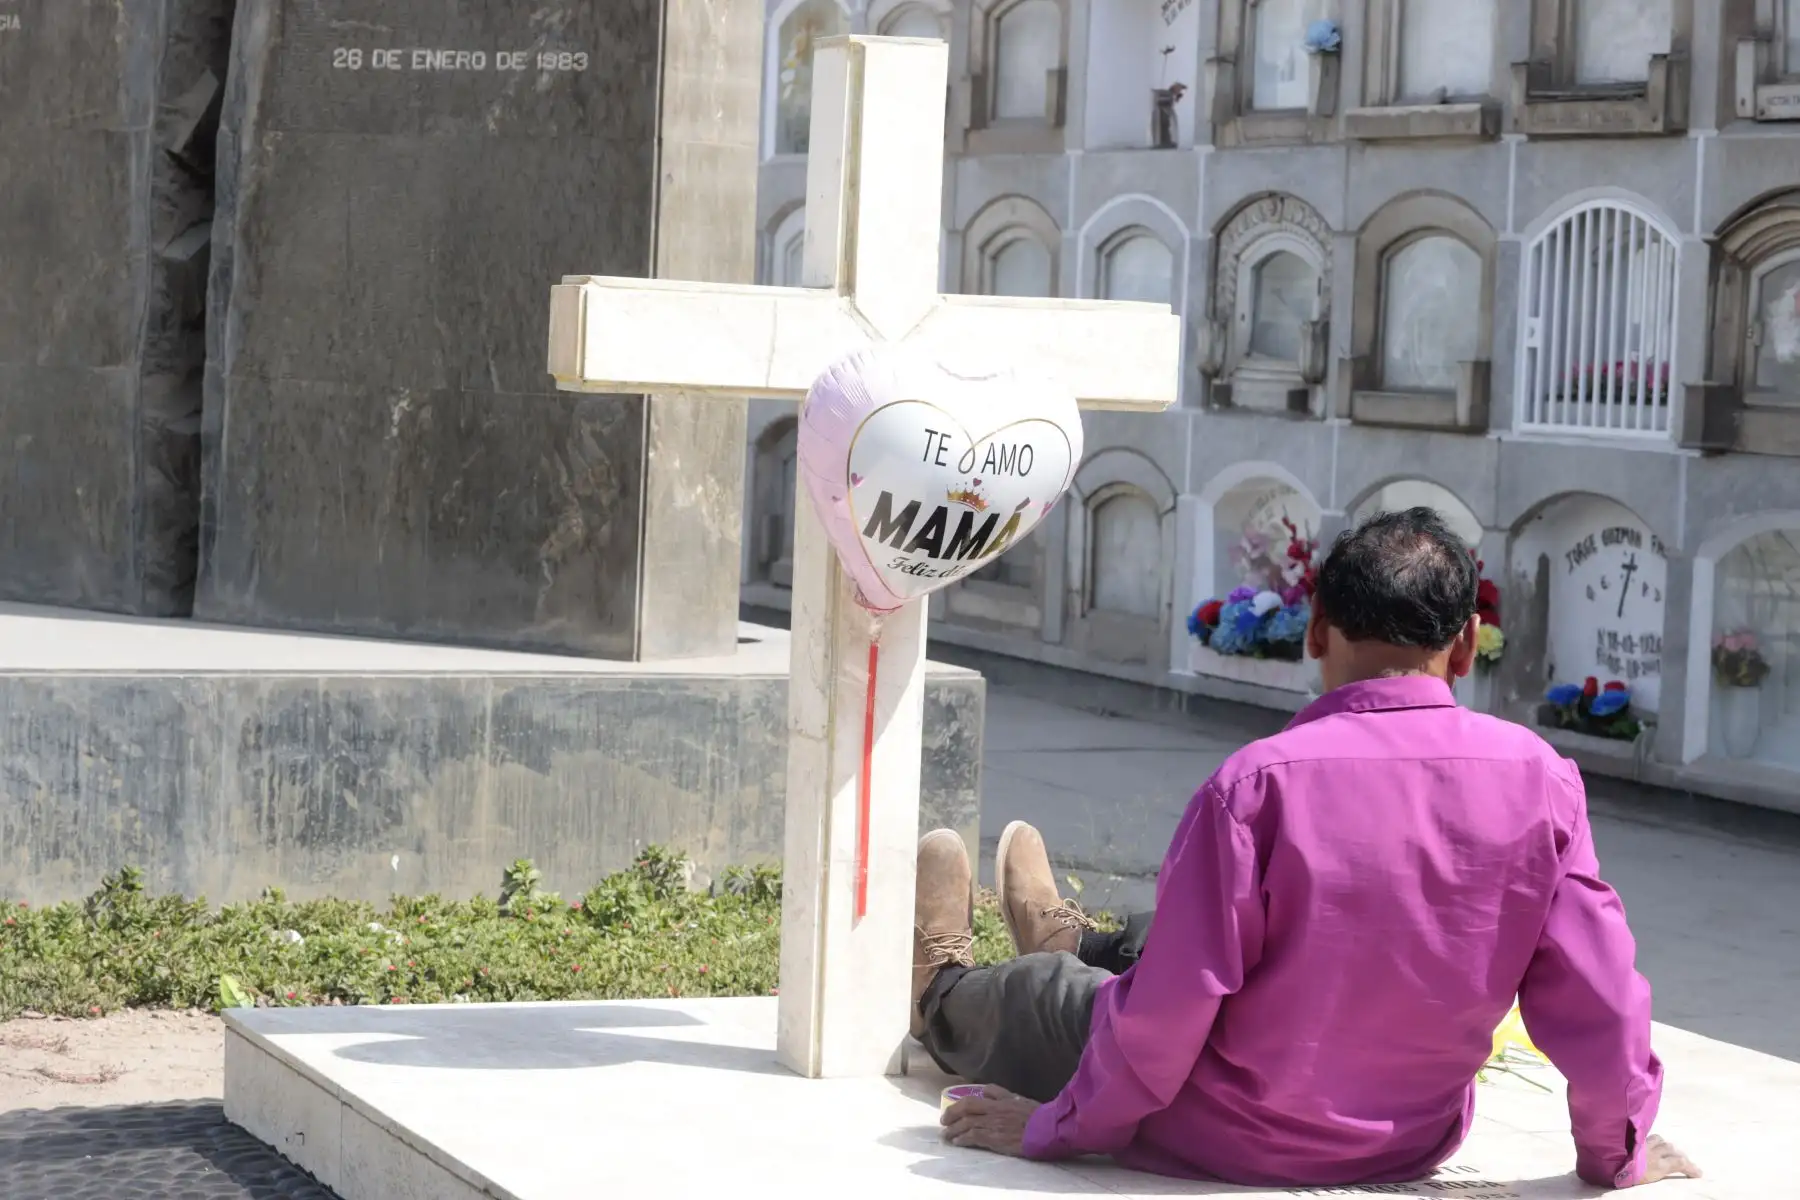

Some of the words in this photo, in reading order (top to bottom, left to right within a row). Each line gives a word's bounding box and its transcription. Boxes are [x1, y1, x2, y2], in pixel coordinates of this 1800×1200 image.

[333, 47, 363, 70] 26
[371, 49, 402, 70] DE
[411, 48, 486, 72] ENERO
[496, 50, 526, 71] DE
[922, 428, 952, 467] TE
[980, 442, 1034, 477] AMO
[862, 490, 1031, 561] MAMÁ
[887, 556, 937, 577] Feliz
[1423, 1180, 1507, 1192] ROCA
